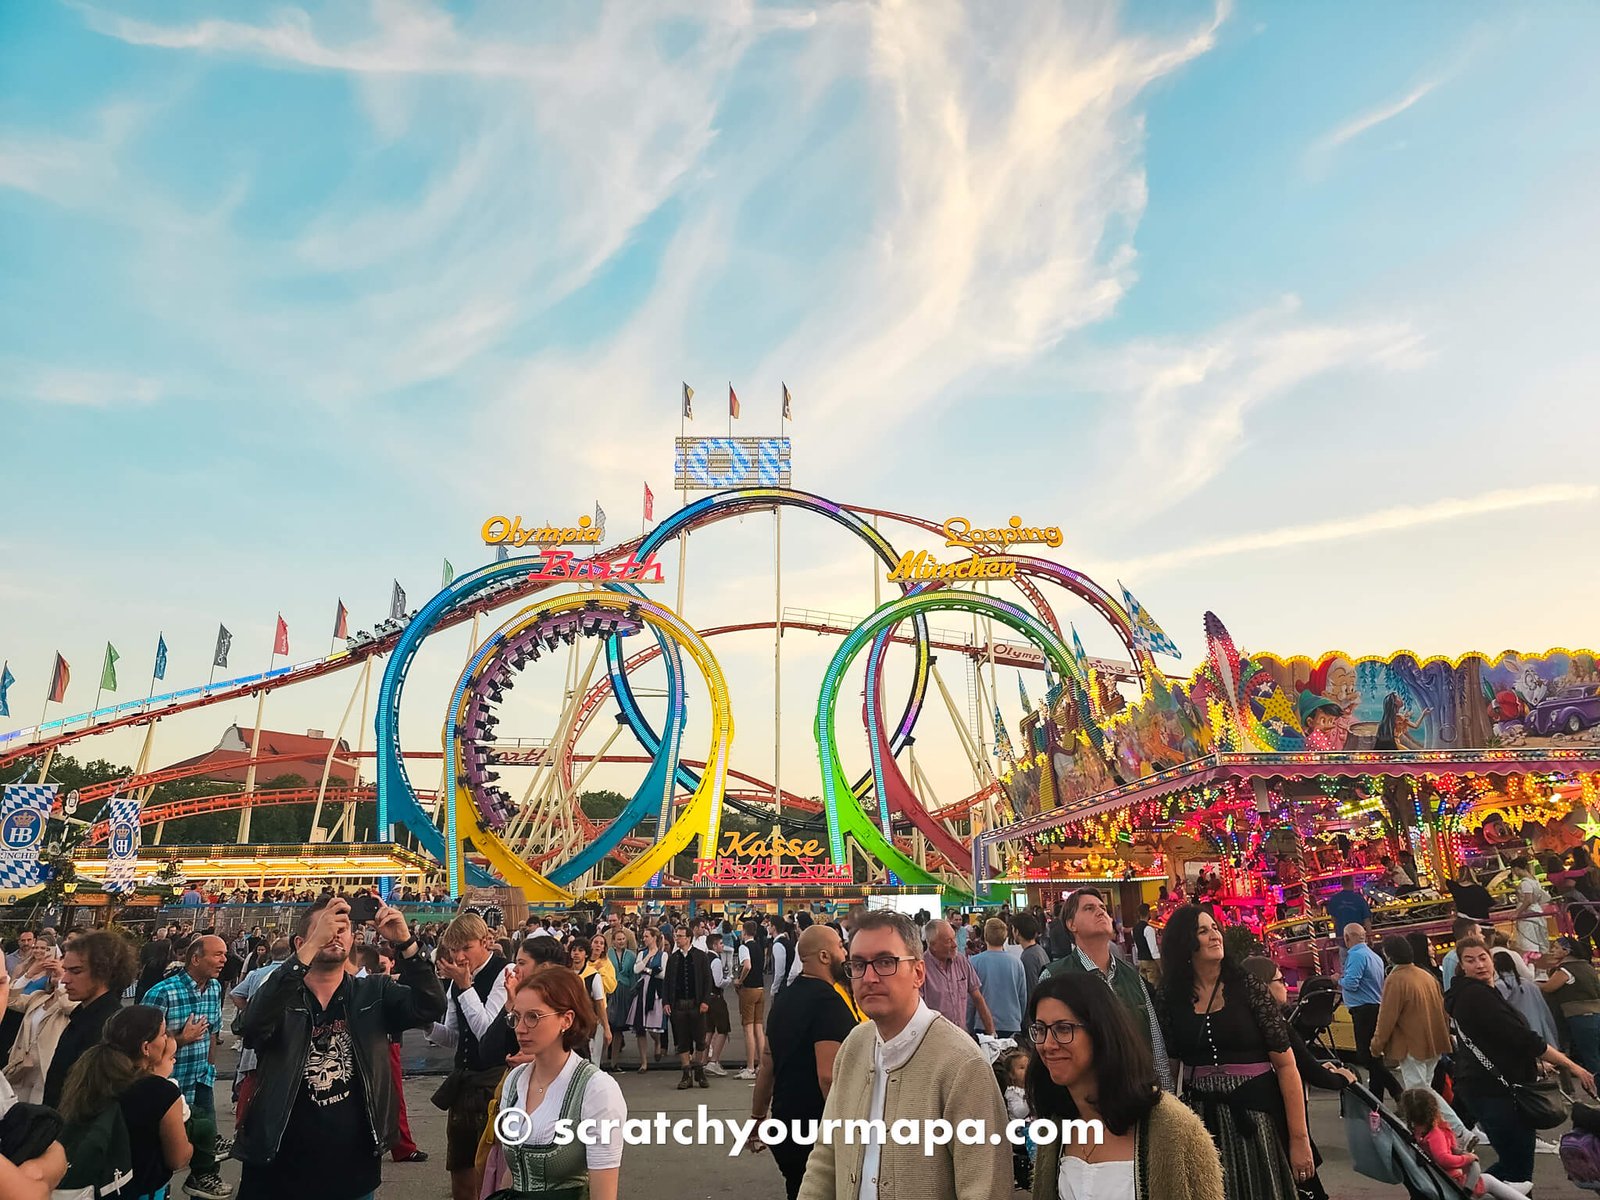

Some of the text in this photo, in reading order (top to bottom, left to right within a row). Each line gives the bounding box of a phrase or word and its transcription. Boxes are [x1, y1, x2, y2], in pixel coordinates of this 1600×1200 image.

[481, 515, 602, 547] Olympia
[943, 515, 1063, 547] Looping
[528, 550, 664, 581] Barth
[887, 550, 1017, 580] München
[993, 643, 1126, 674] Olymp ping
[8, 827, 33, 843] HB
[718, 831, 825, 857] Kasse
[798, 858, 852, 878] Sohn
